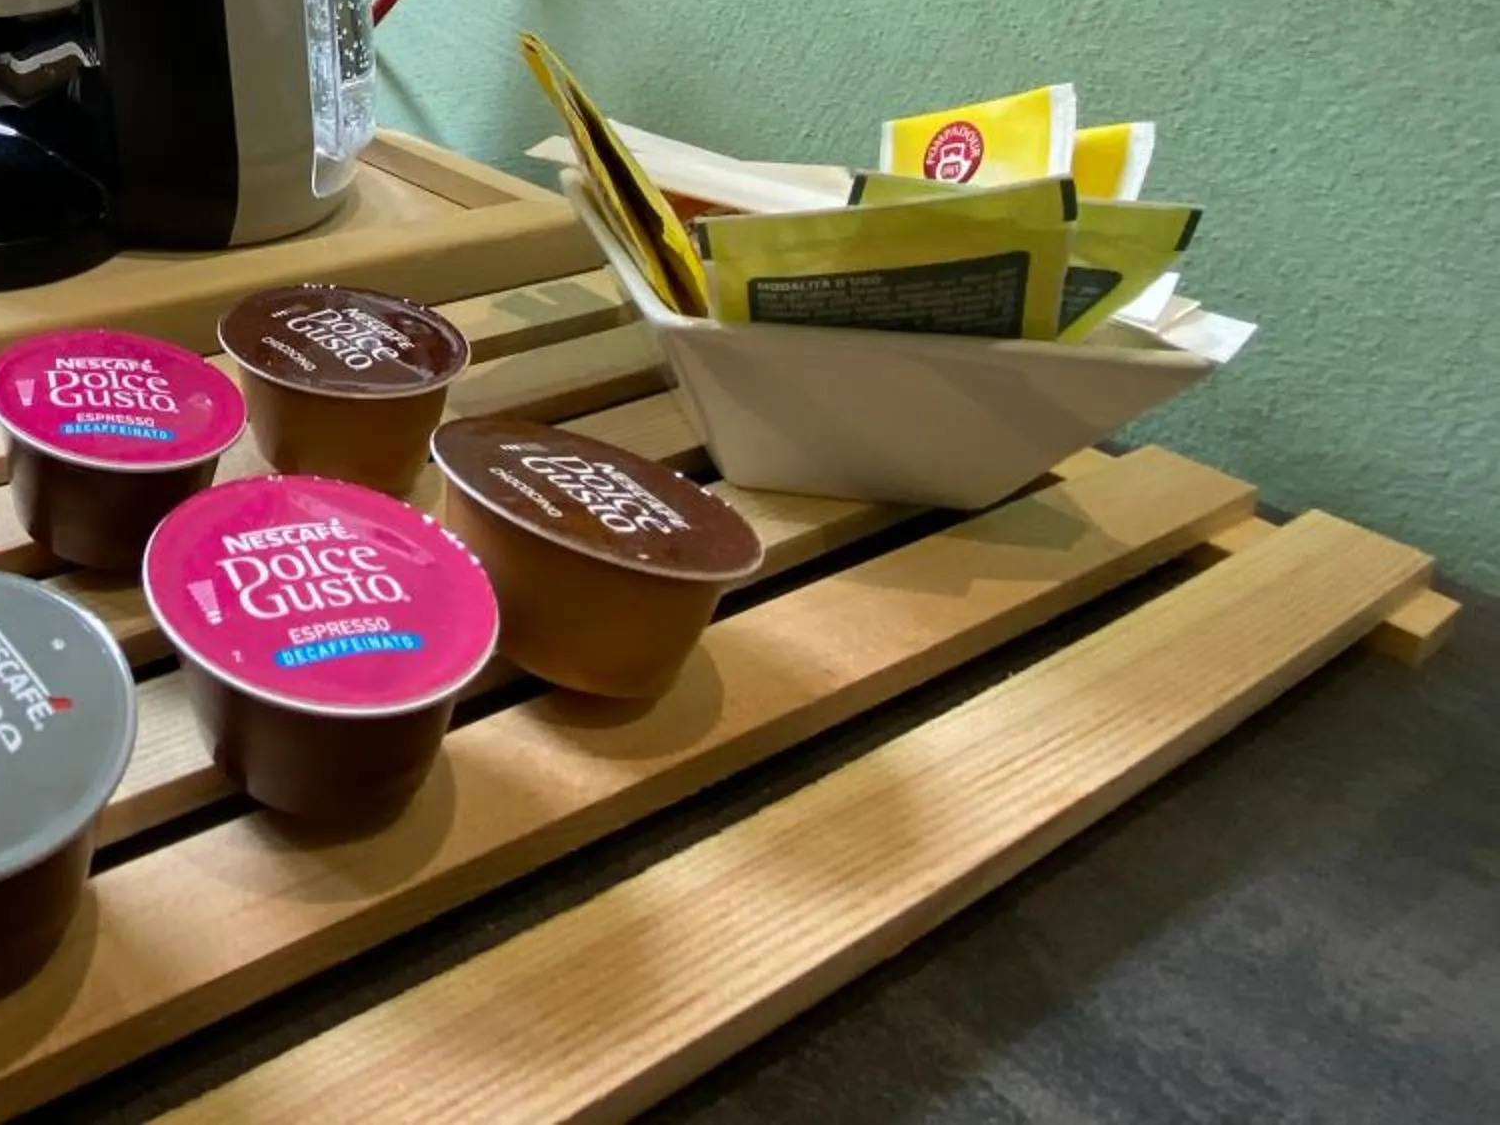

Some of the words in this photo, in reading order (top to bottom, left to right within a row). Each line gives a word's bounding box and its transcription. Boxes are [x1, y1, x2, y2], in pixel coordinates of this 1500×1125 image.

[926, 126, 981, 165] POMPADOUR
[287, 316, 373, 370] Gusto
[303, 308, 399, 361] Dolce
[44, 370, 171, 395] Dolce
[55, 357, 156, 374] NESCAFÉ
[49, 386, 177, 413] Gusto
[64, 425, 168, 440] DECAFFEINATO
[76, 412, 155, 426] ESPRESSO
[521, 456, 637, 534] Gusto
[547, 456, 672, 535] Dolce
[221, 518, 353, 556] NESCAFÉ
[216, 543, 388, 591] Dolce
[239, 571, 408, 619] Gusto
[288, 615, 391, 645] ESPRESSO
[282, 634, 414, 666] DECAFFEINATO
